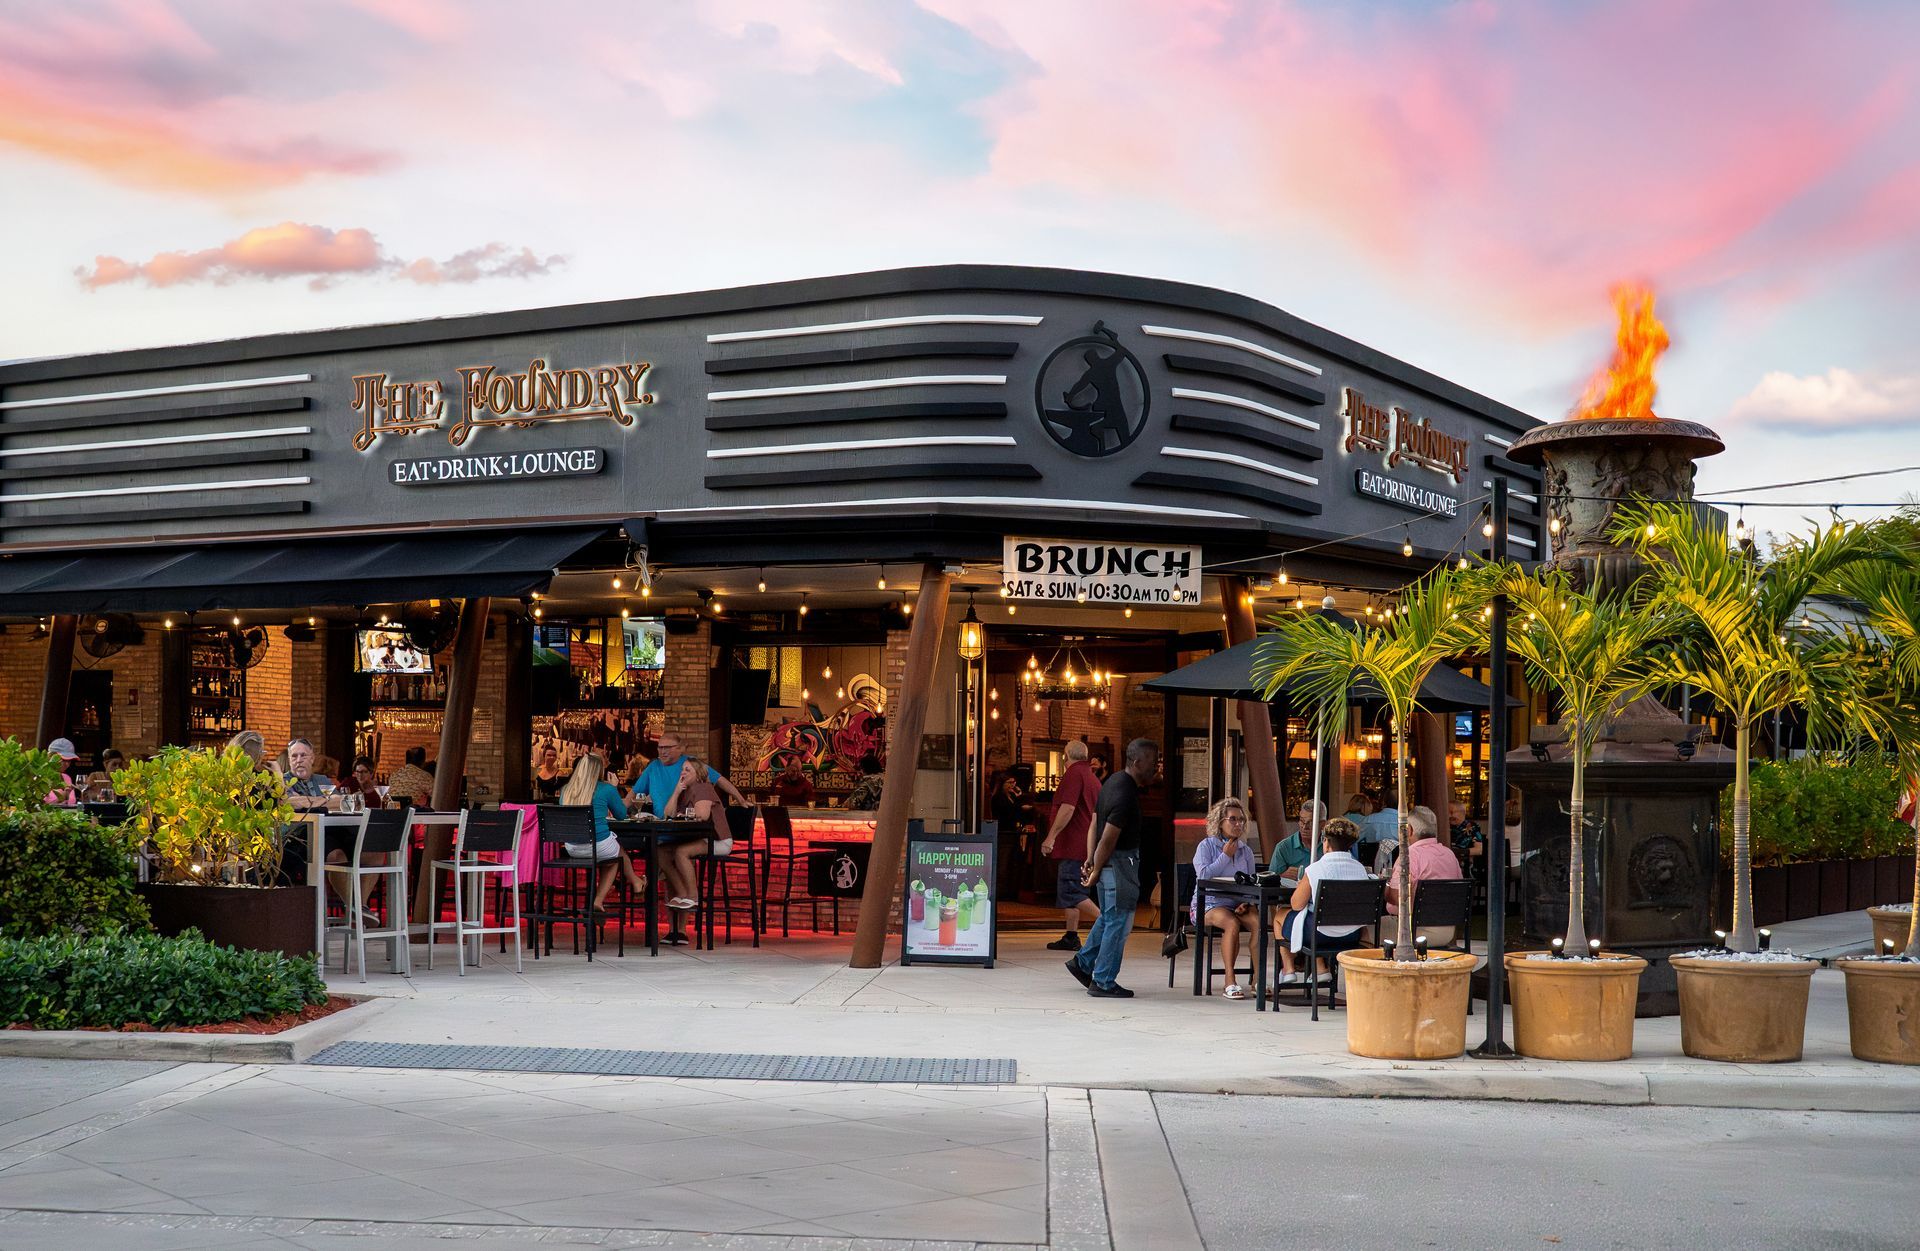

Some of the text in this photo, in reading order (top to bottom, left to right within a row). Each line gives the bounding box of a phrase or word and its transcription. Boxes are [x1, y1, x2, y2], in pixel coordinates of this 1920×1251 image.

[351, 373, 444, 451] THE
[1344, 387, 1390, 453] THE
[1014, 542, 1191, 579] BRUNCH
[1006, 580, 1034, 597] SAT
[1035, 583, 1045, 598] &
[1048, 581, 1077, 599] SUN
[1154, 588, 1170, 602] TO
[918, 852, 985, 866] HAPPY HOUR!
